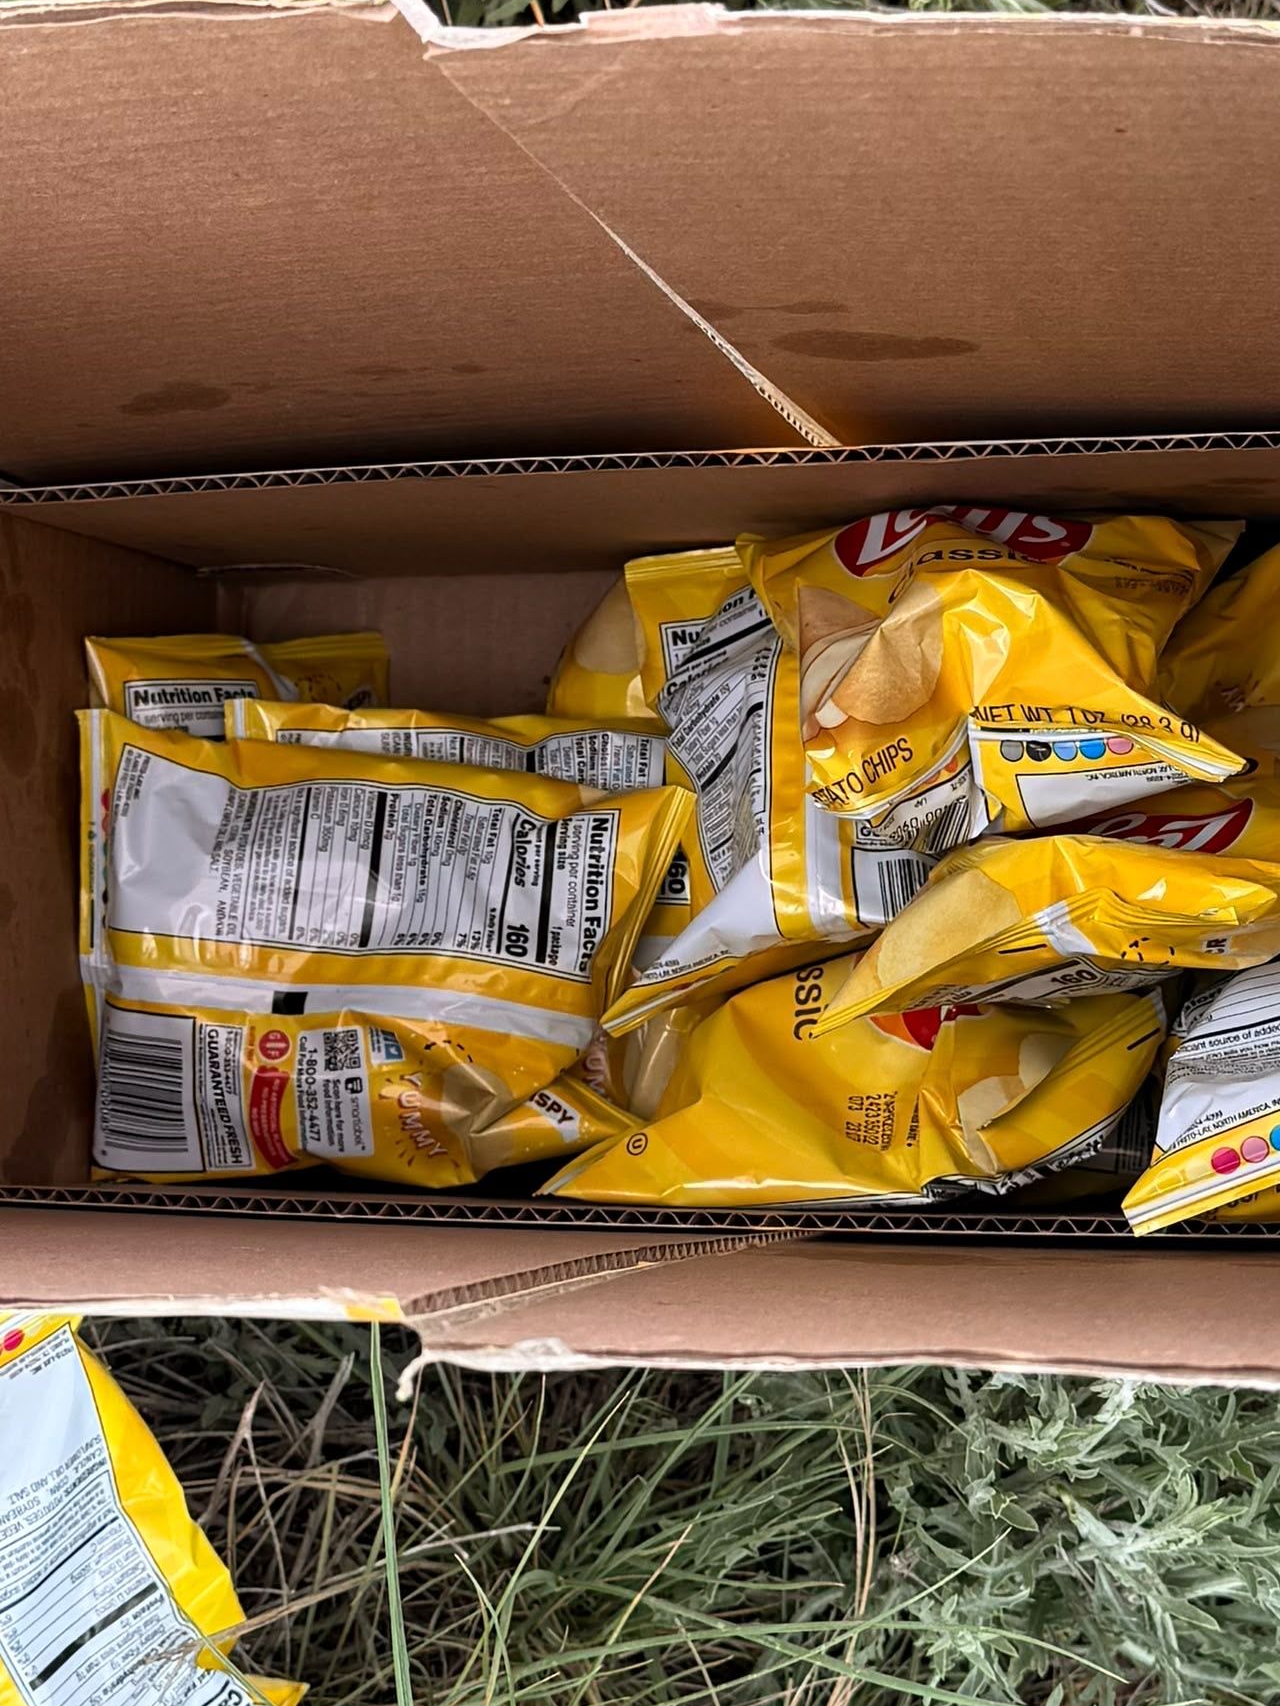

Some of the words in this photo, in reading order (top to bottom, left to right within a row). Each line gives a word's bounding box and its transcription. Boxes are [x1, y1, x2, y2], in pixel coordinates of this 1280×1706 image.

[133, 688, 212, 705] Nutrition
[1020, 701, 1053, 725] WT
[1121, 709, 1173, 737] (283
[639, 738, 648, 760] Total
[857, 735, 917, 784] CHIPS
[637, 762, 647, 777] Fat
[386, 792, 398, 828] Protein
[424, 793, 436, 816] Total
[436, 795, 449, 828] Sodium
[446, 799, 462, 848] Cholesterol
[489, 807, 502, 830] Total
[416, 818, 433, 885] Carbohydrate
[486, 832, 497, 848] Fat
[509, 818, 536, 888] Calories
[567, 824, 584, 861] serving
[567, 861, 579, 878] per
[581, 817, 611, 911] Nutrition
[563, 880, 580, 927] container
[469, 929, 481, 951] 13%
[503, 922, 530, 958] 160
[546, 930, 563, 966] package
[578, 914, 601, 974] Facts
[1050, 967, 1098, 988] 160
[793, 967, 824, 1042] ssic
[299, 1036, 307, 1052] Call
[1208, 1034, 1241, 1047] source
[1241, 1029, 1252, 1039] of
[297, 1053, 306, 1066] For
[207, 1029, 230, 1122] GUARANTEED
[223, 1123, 242, 1164] FRESH
[297, 1090, 306, 1108] Food
[303, 1048, 320, 1142] 1-800-352-4477
[322, 1079, 331, 1098] food
[332, 1079, 341, 1099] Scan
[324, 1099, 334, 1146] information
[333, 1100, 342, 1118] here
[397, 1067, 450, 1158] YUMMY
[527, 1091, 573, 1127] ISPY
[1211, 1113, 1238, 1131] NORTH
[335, 1119, 344, 1131] for
[336, 1133, 344, 1152] more
[28, 1474, 49, 1492] AND
[130, 1592, 165, 1623] Protein
